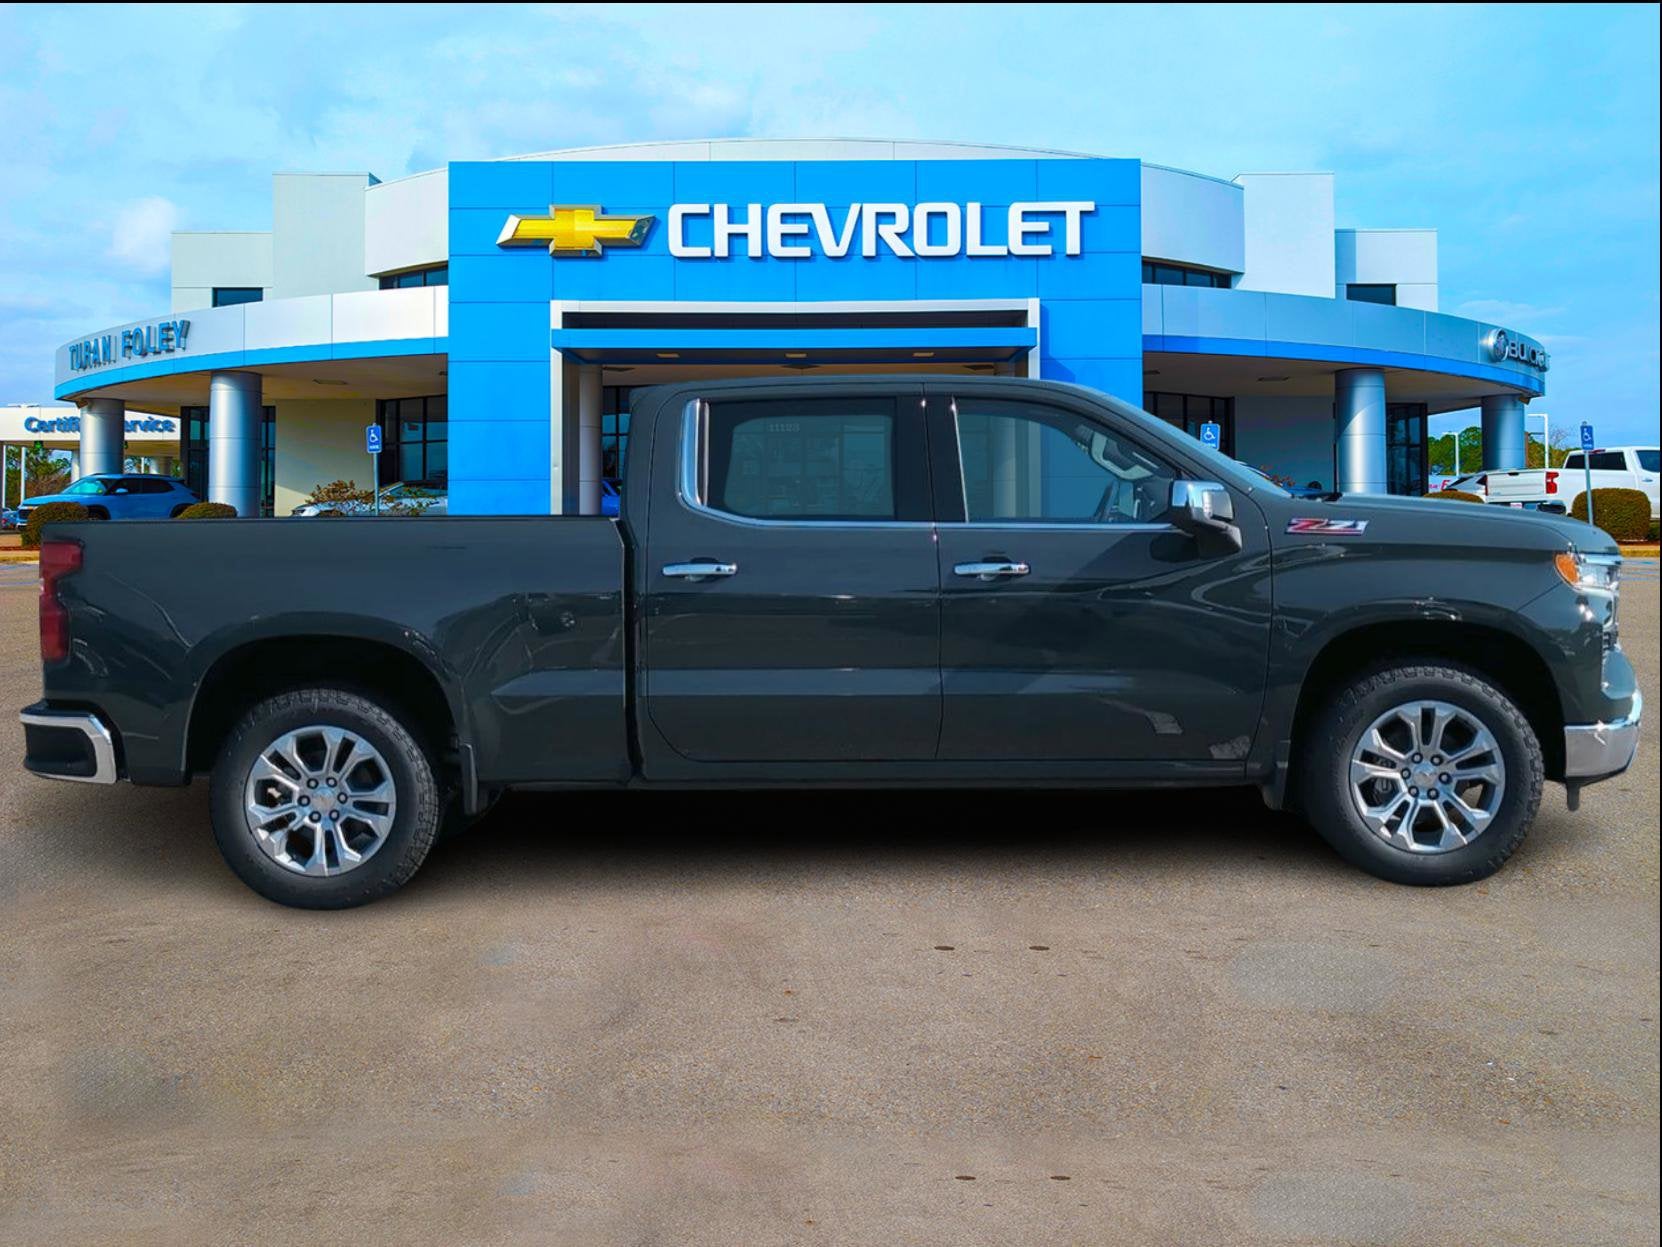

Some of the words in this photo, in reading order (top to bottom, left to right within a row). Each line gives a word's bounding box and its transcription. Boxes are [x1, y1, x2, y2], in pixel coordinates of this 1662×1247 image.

[668, 202, 1095, 258] CHEVROLET
[69, 335, 117, 371] TURAN
[121, 319, 190, 360] FOLEY
[1286, 518, 1368, 535] Z71
